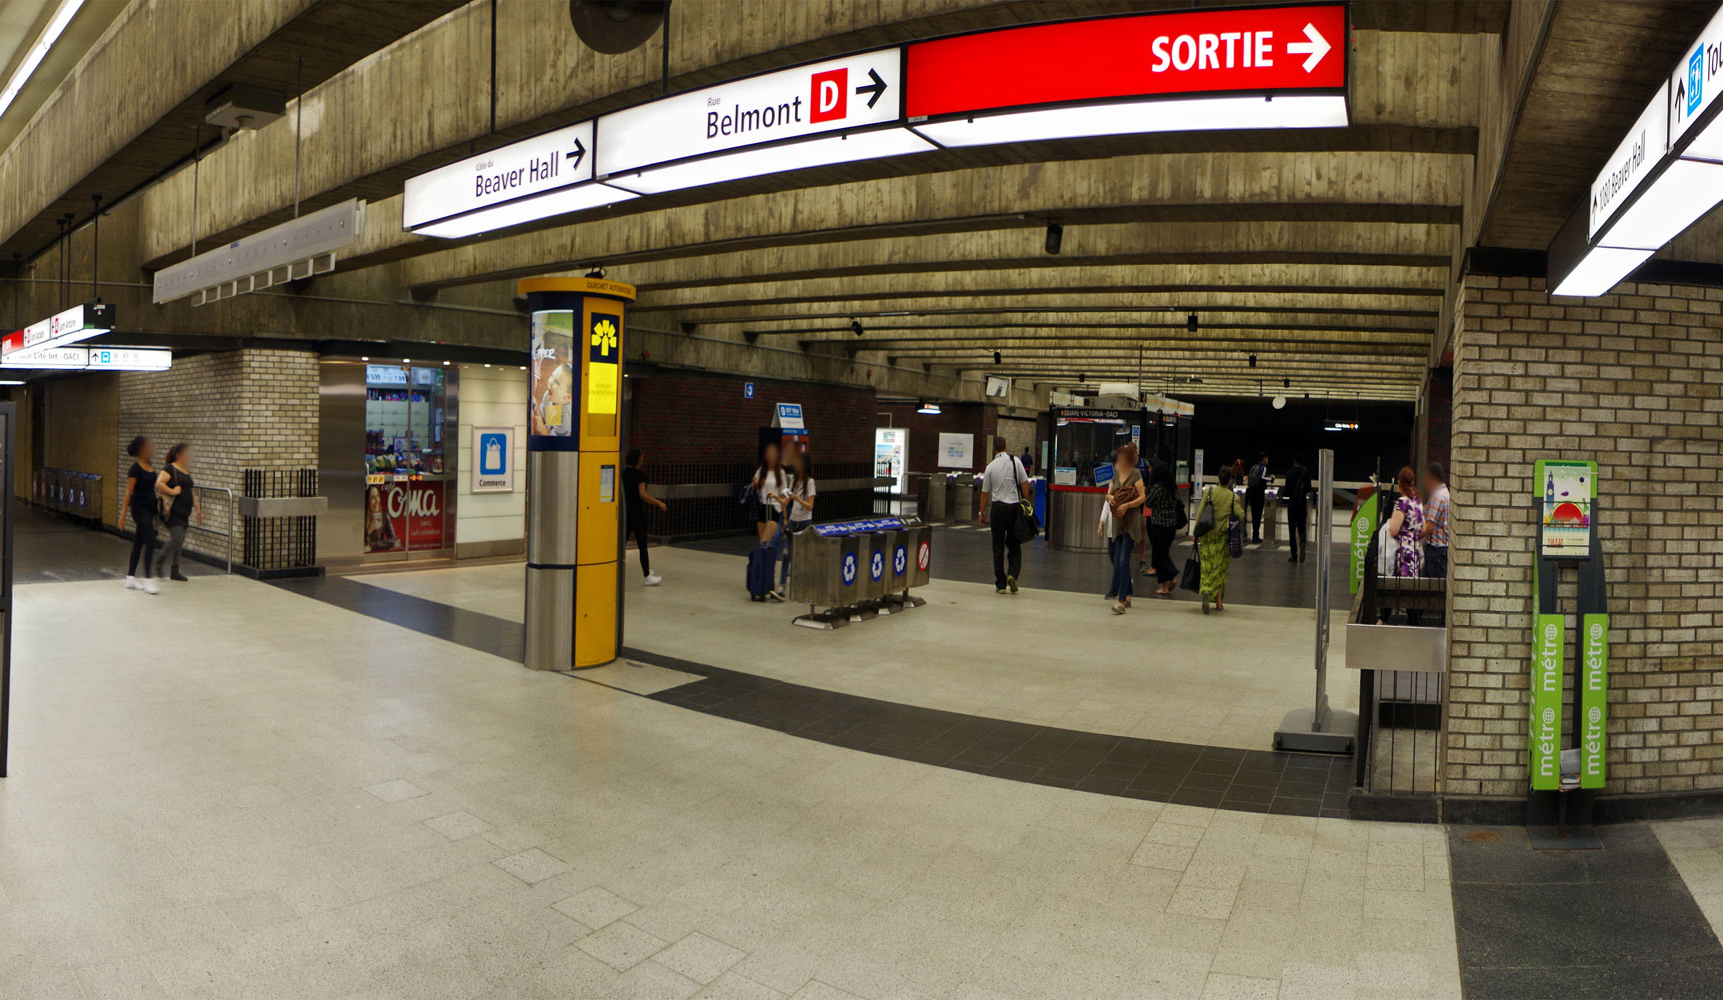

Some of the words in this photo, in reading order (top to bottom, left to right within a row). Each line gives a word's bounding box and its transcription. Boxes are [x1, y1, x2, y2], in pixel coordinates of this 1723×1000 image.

[1150, 30, 1274, 73] SORTIE
[706, 95, 802, 139] Belmont
[707, 96, 721, 107] Rue
[819, 80, 839, 114] D
[475, 162, 487, 172] Côte
[475, 166, 524, 197] Beaver
[529, 150, 559, 183] Hall
[1599, 176, 1611, 214] 1080
[1611, 156, 1632, 199] Beaver
[1632, 129, 1646, 174] Hall
[479, 478, 506, 488] Commerce
[1541, 623, 1558, 692] métro
[1587, 622, 1604, 692] métro
[1539, 707, 1556, 777] métro
[1585, 705, 1602, 777] métro
